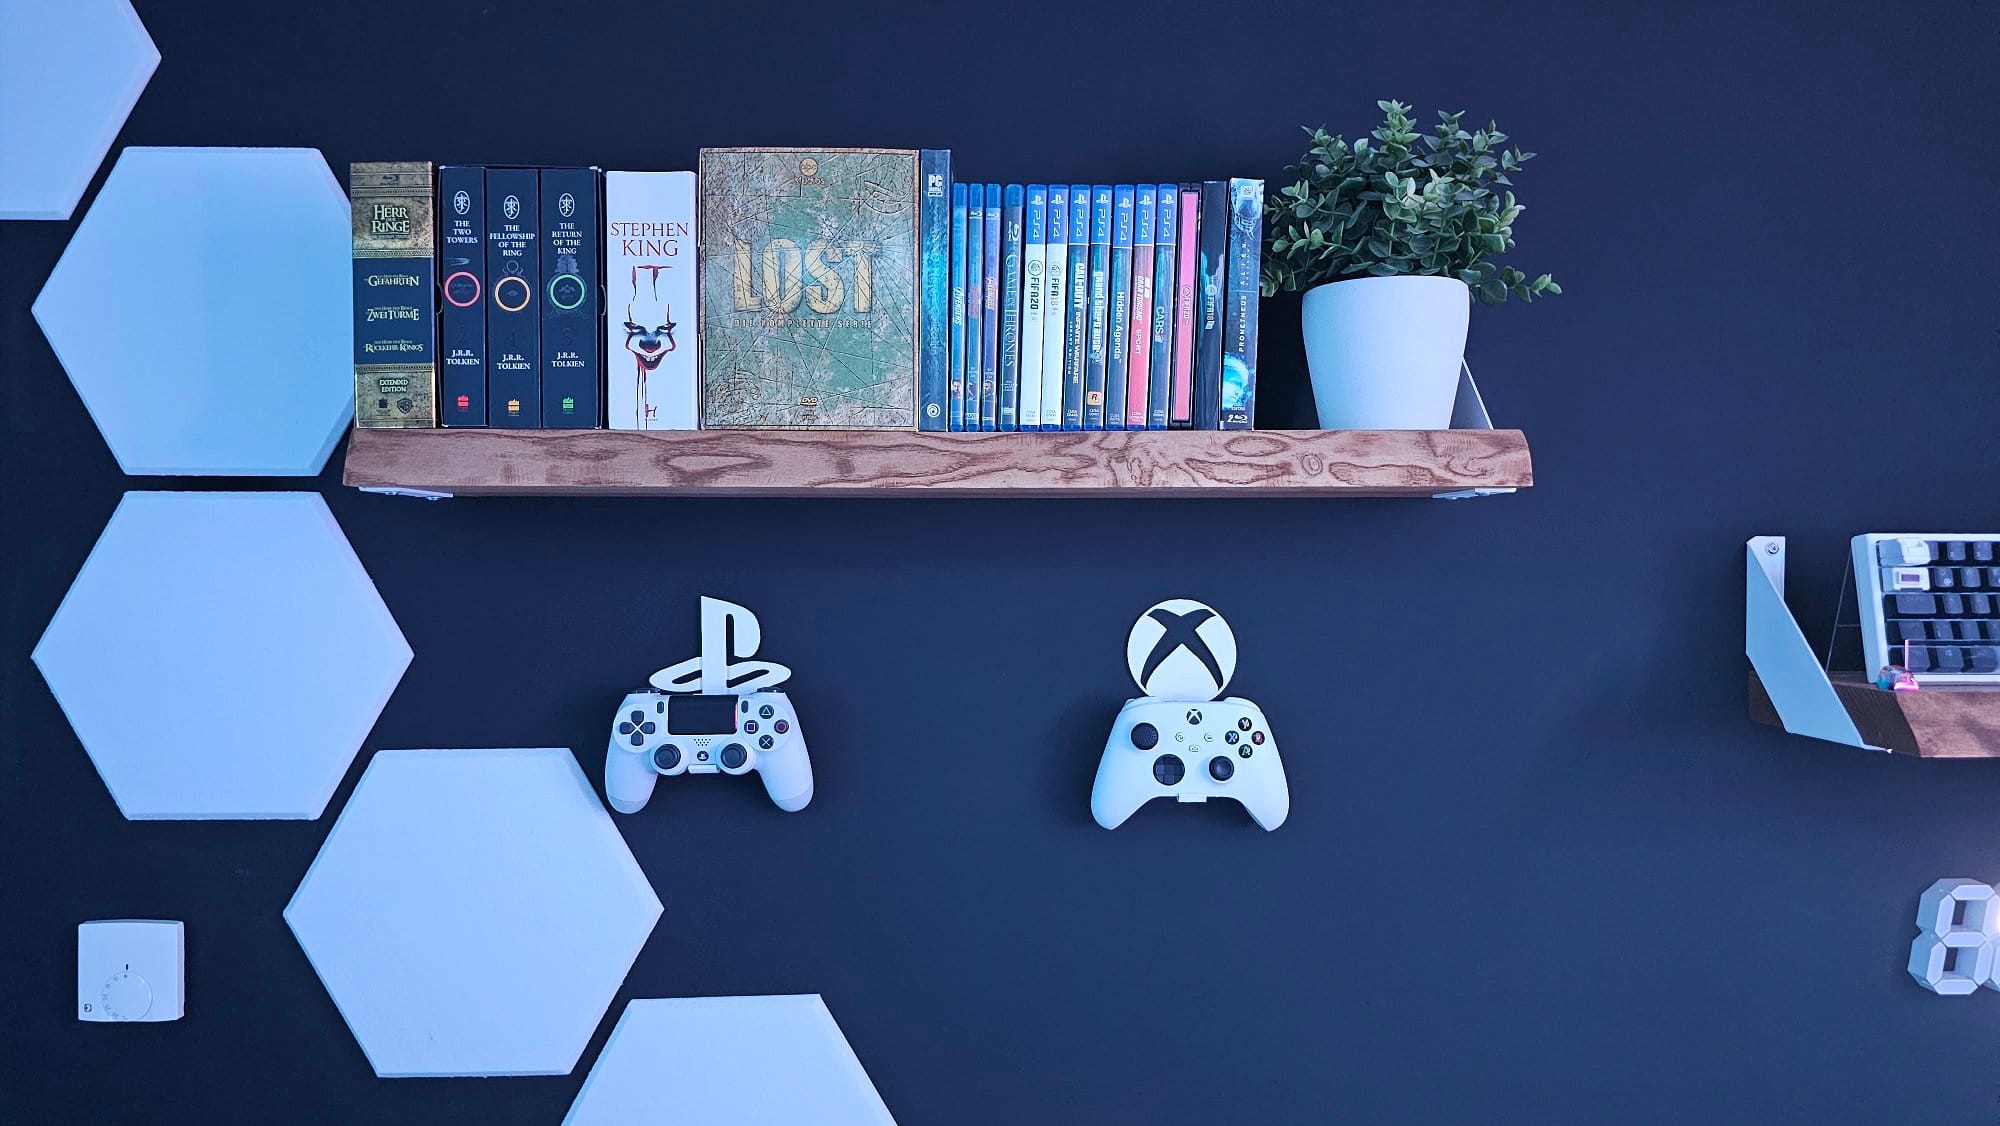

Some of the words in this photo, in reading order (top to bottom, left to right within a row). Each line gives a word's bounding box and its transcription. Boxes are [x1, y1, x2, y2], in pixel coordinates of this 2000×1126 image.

[373, 204, 409, 220] HERR
[372, 220, 410, 233] RINGE
[504, 224, 520, 232] THE
[559, 222, 575, 230] THE
[610, 222, 688, 237] STEPHEN
[1033, 210, 1041, 240] PS4
[1053, 209, 1061, 239] PS4
[1076, 209, 1084, 238] PS4
[1097, 209, 1105, 238] PS4
[1120, 213, 1128, 242] PS4
[1141, 210, 1149, 240] PS4
[1163, 209, 1171, 238] PS4
[446, 236, 478, 244] TOWERS
[489, 232, 536, 240] FELLOWSHIP
[551, 230, 583, 238] RETURN
[502, 249, 523, 257] RING
[557, 247, 577, 255] KING
[622, 239, 678, 257] KING
[631, 265, 673, 302] IT
[733, 237, 882, 314] LOST
[1074, 286, 1085, 309] DUTY
[1116, 291, 1125, 323] Hidden
[1155, 306, 1165, 334] CARS
[1238, 295, 1247, 352] PROMETHEUS
[1004, 309, 1017, 367] THRONES
[451, 350, 474, 358] J.R.R.
[502, 354, 525, 362] J.R.R.
[497, 362, 531, 370] TOLKIEN
[551, 360, 585, 368] TOLKIEN
